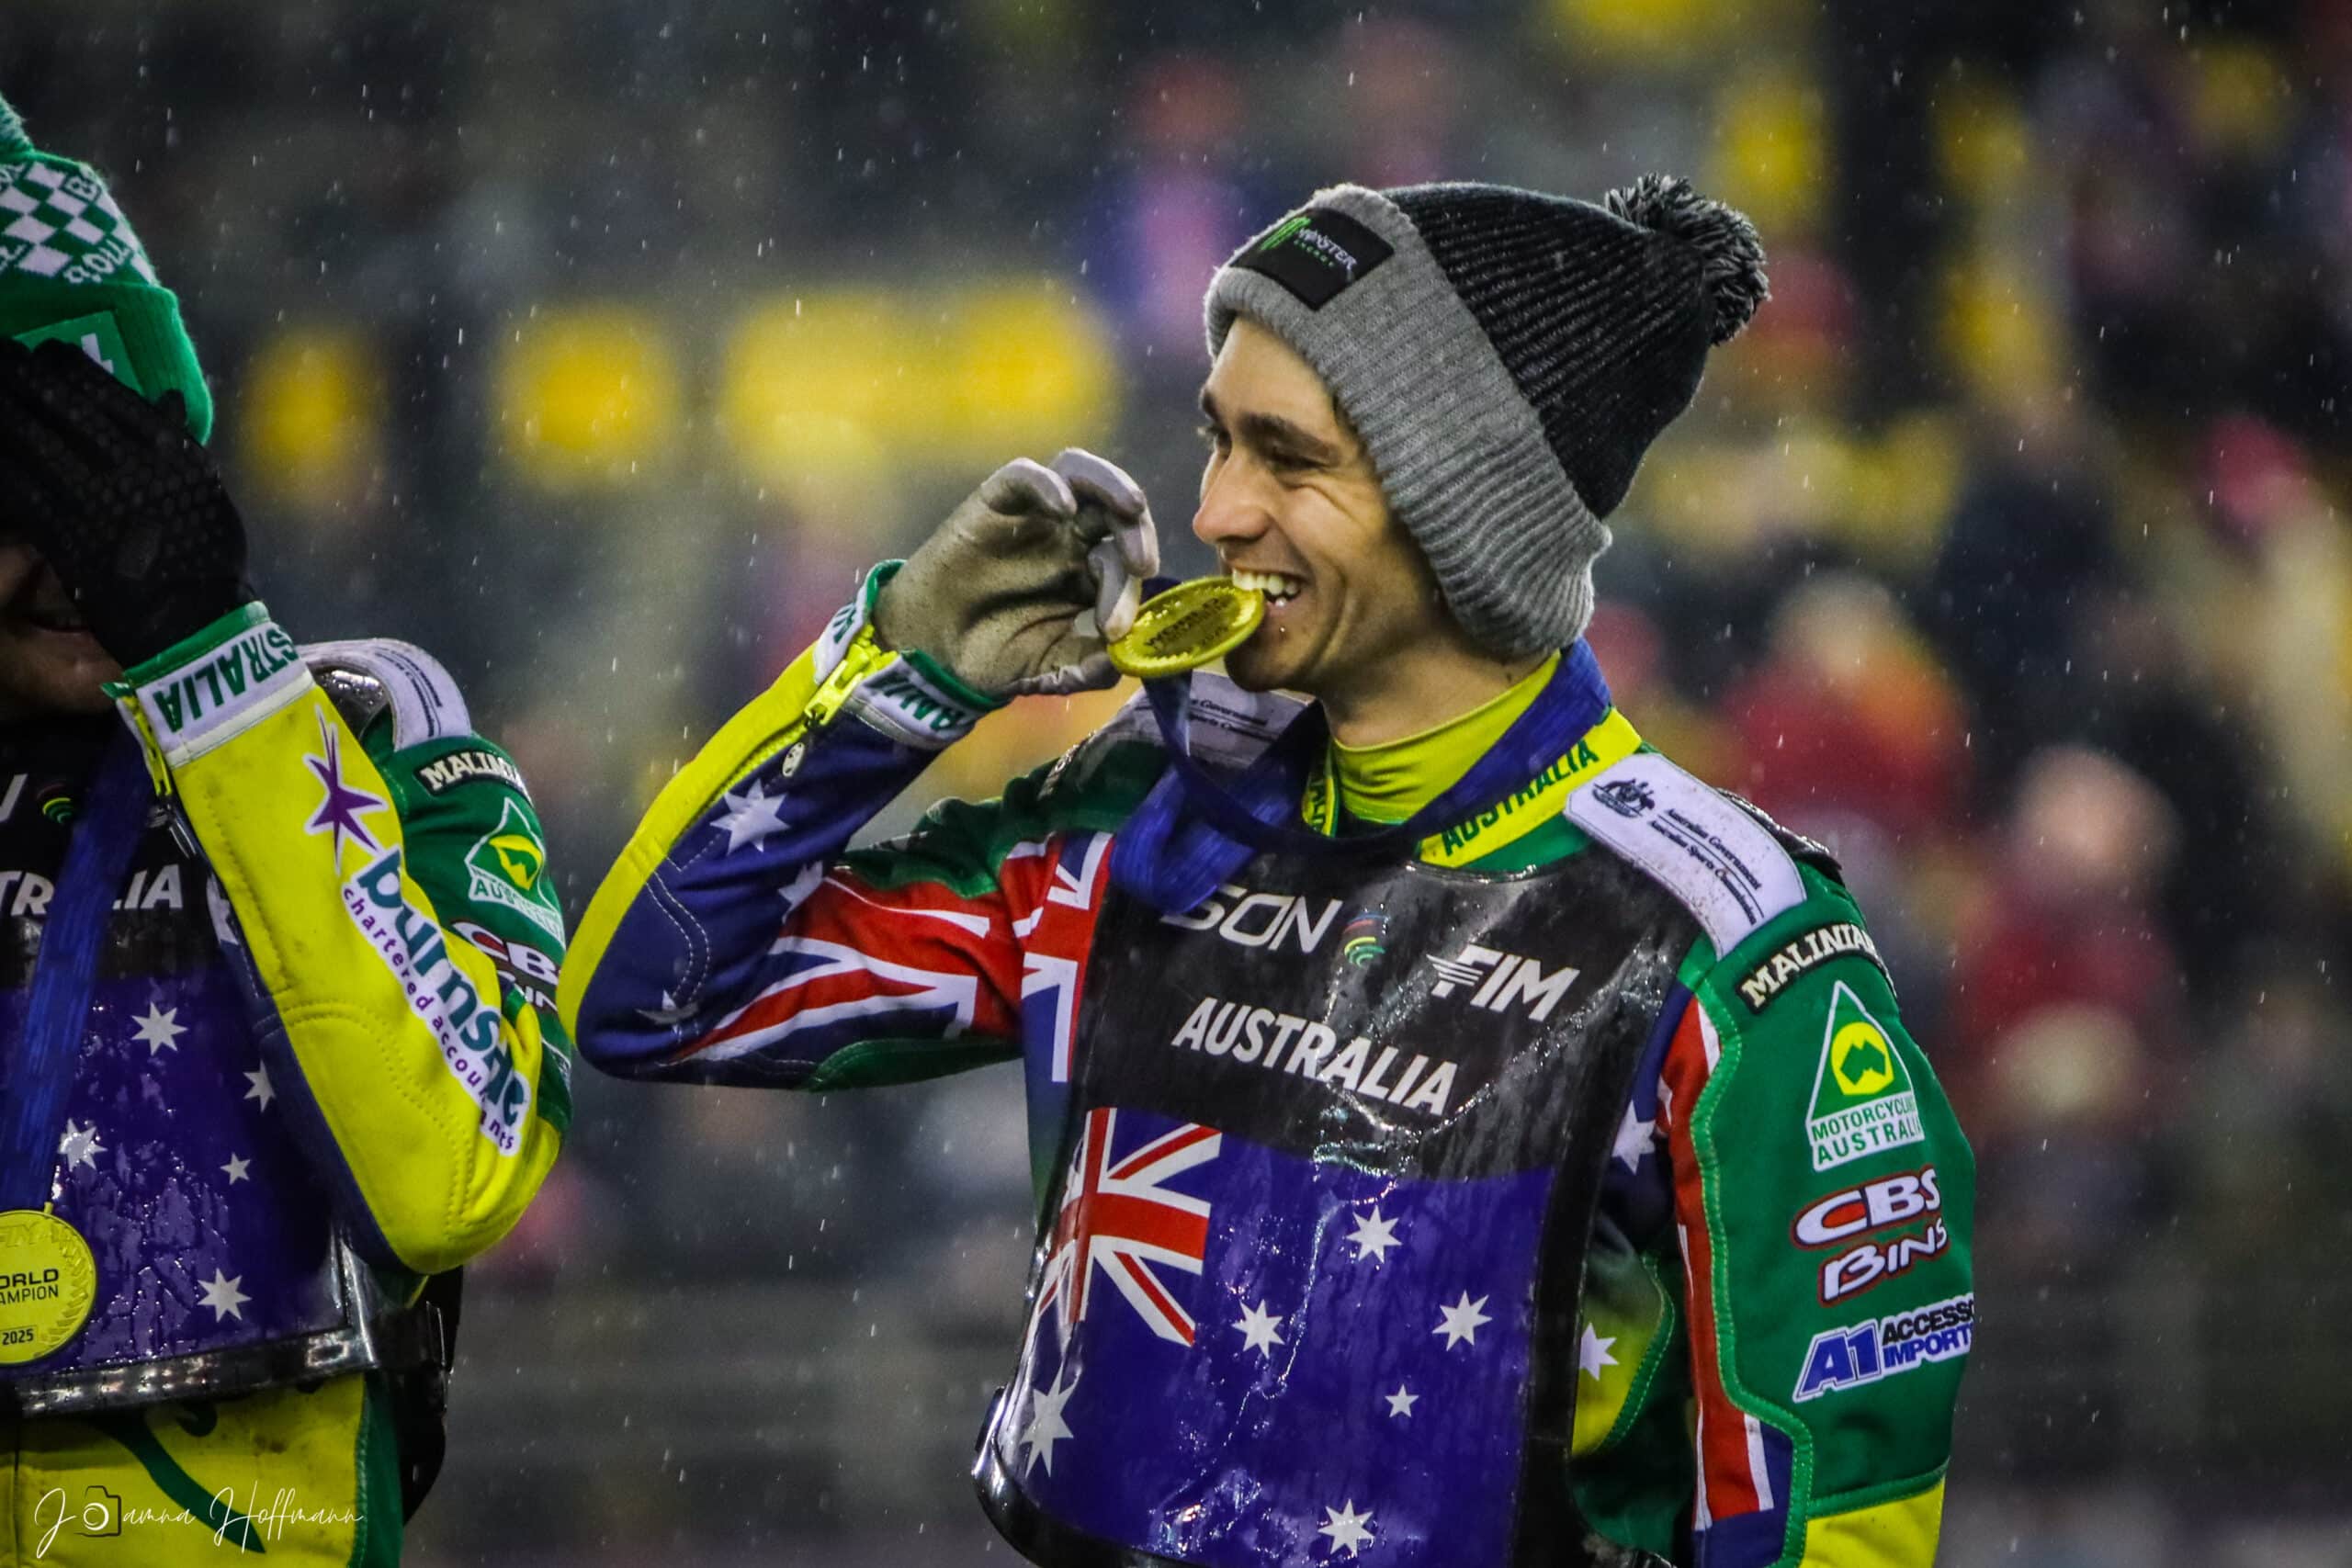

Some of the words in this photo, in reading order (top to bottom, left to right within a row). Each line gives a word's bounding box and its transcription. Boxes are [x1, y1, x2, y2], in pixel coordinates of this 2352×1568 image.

[343, 886, 435, 1011] chartered
[1426, 943, 1581, 1022] FIM
[1171, 997, 1458, 1117] AUSTRALIA
[1796, 1168, 1940, 1245] CBS
[1823, 1217, 1948, 1301] BINS
[2, 1327, 34, 1346] 2025
[1799, 1322, 1881, 1395] A1
[1883, 1322, 1973, 1369] IMPORT
